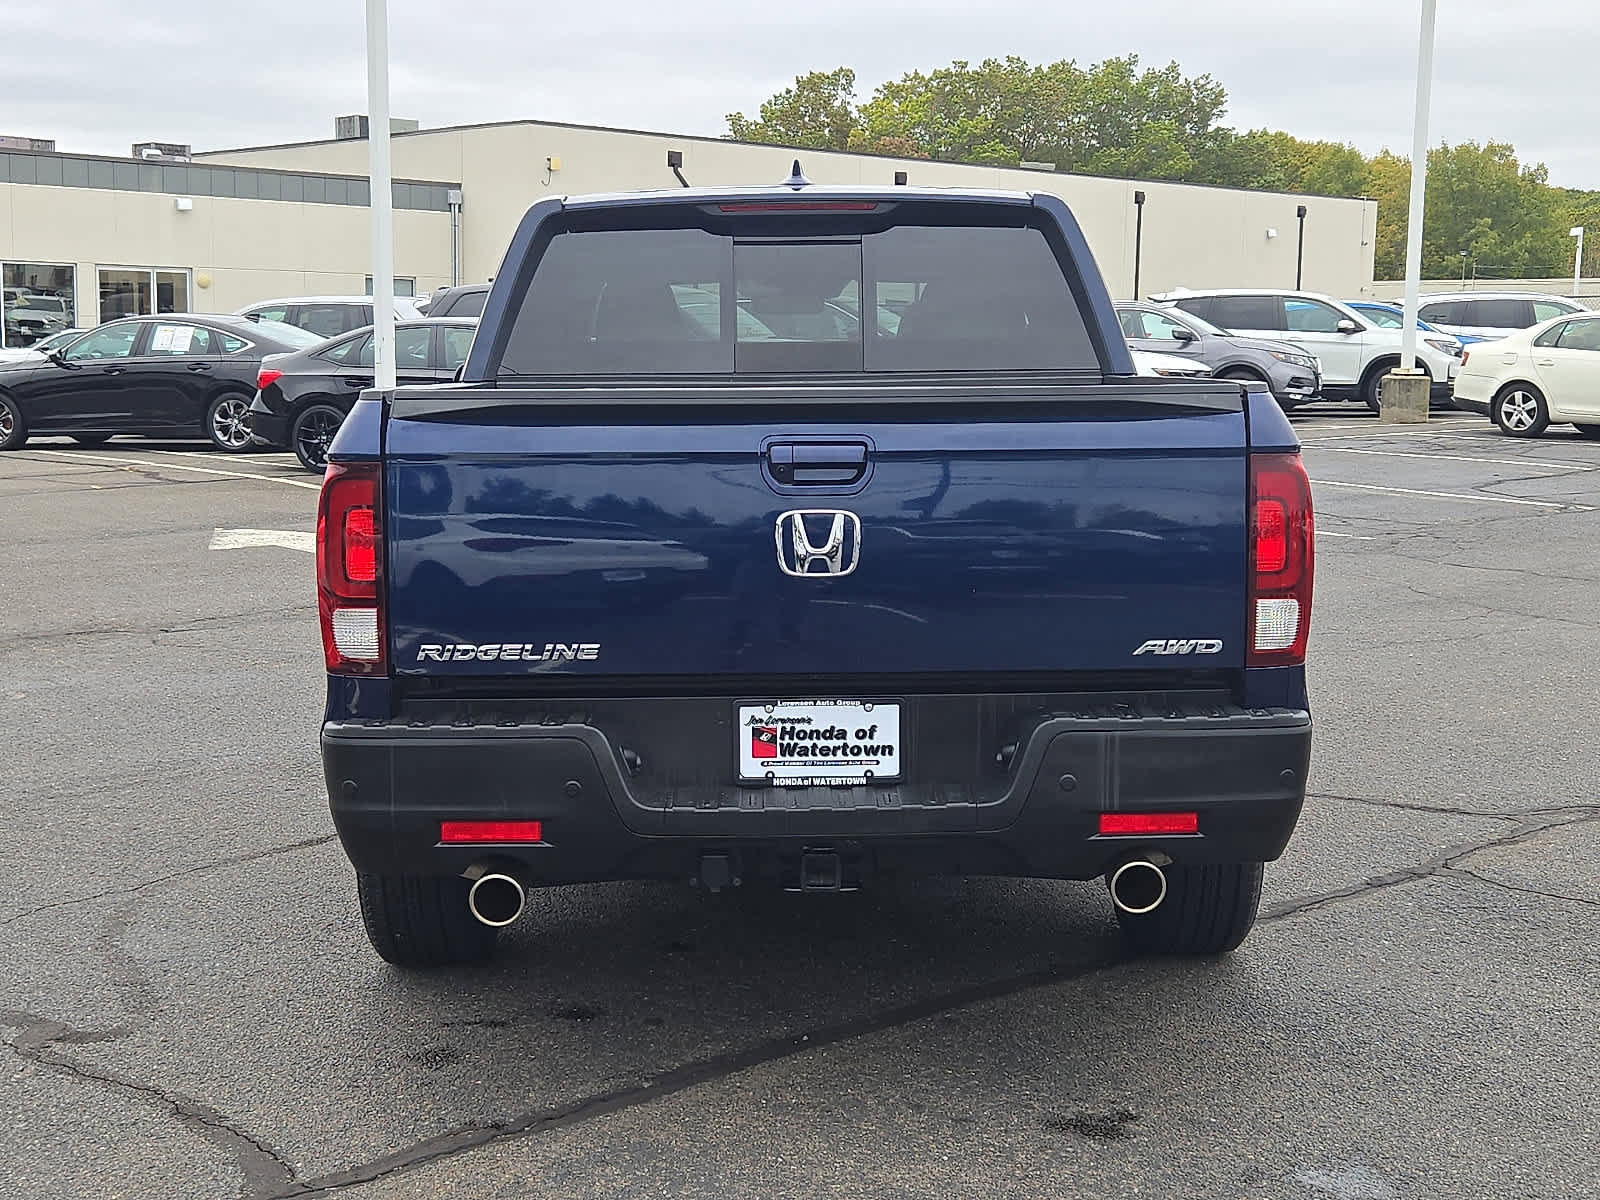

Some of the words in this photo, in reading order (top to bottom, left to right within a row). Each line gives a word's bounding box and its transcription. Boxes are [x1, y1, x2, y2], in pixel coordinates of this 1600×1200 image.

[416, 643, 601, 662] RIDGELINE
[1132, 639, 1223, 656] AWD
[779, 726, 848, 741] Honda
[855, 725, 878, 740] of
[779, 742, 895, 757] Watertown
[773, 777, 803, 786] HONDA
[803, 778, 812, 786] of
[812, 776, 867, 786] WATERTOWN
